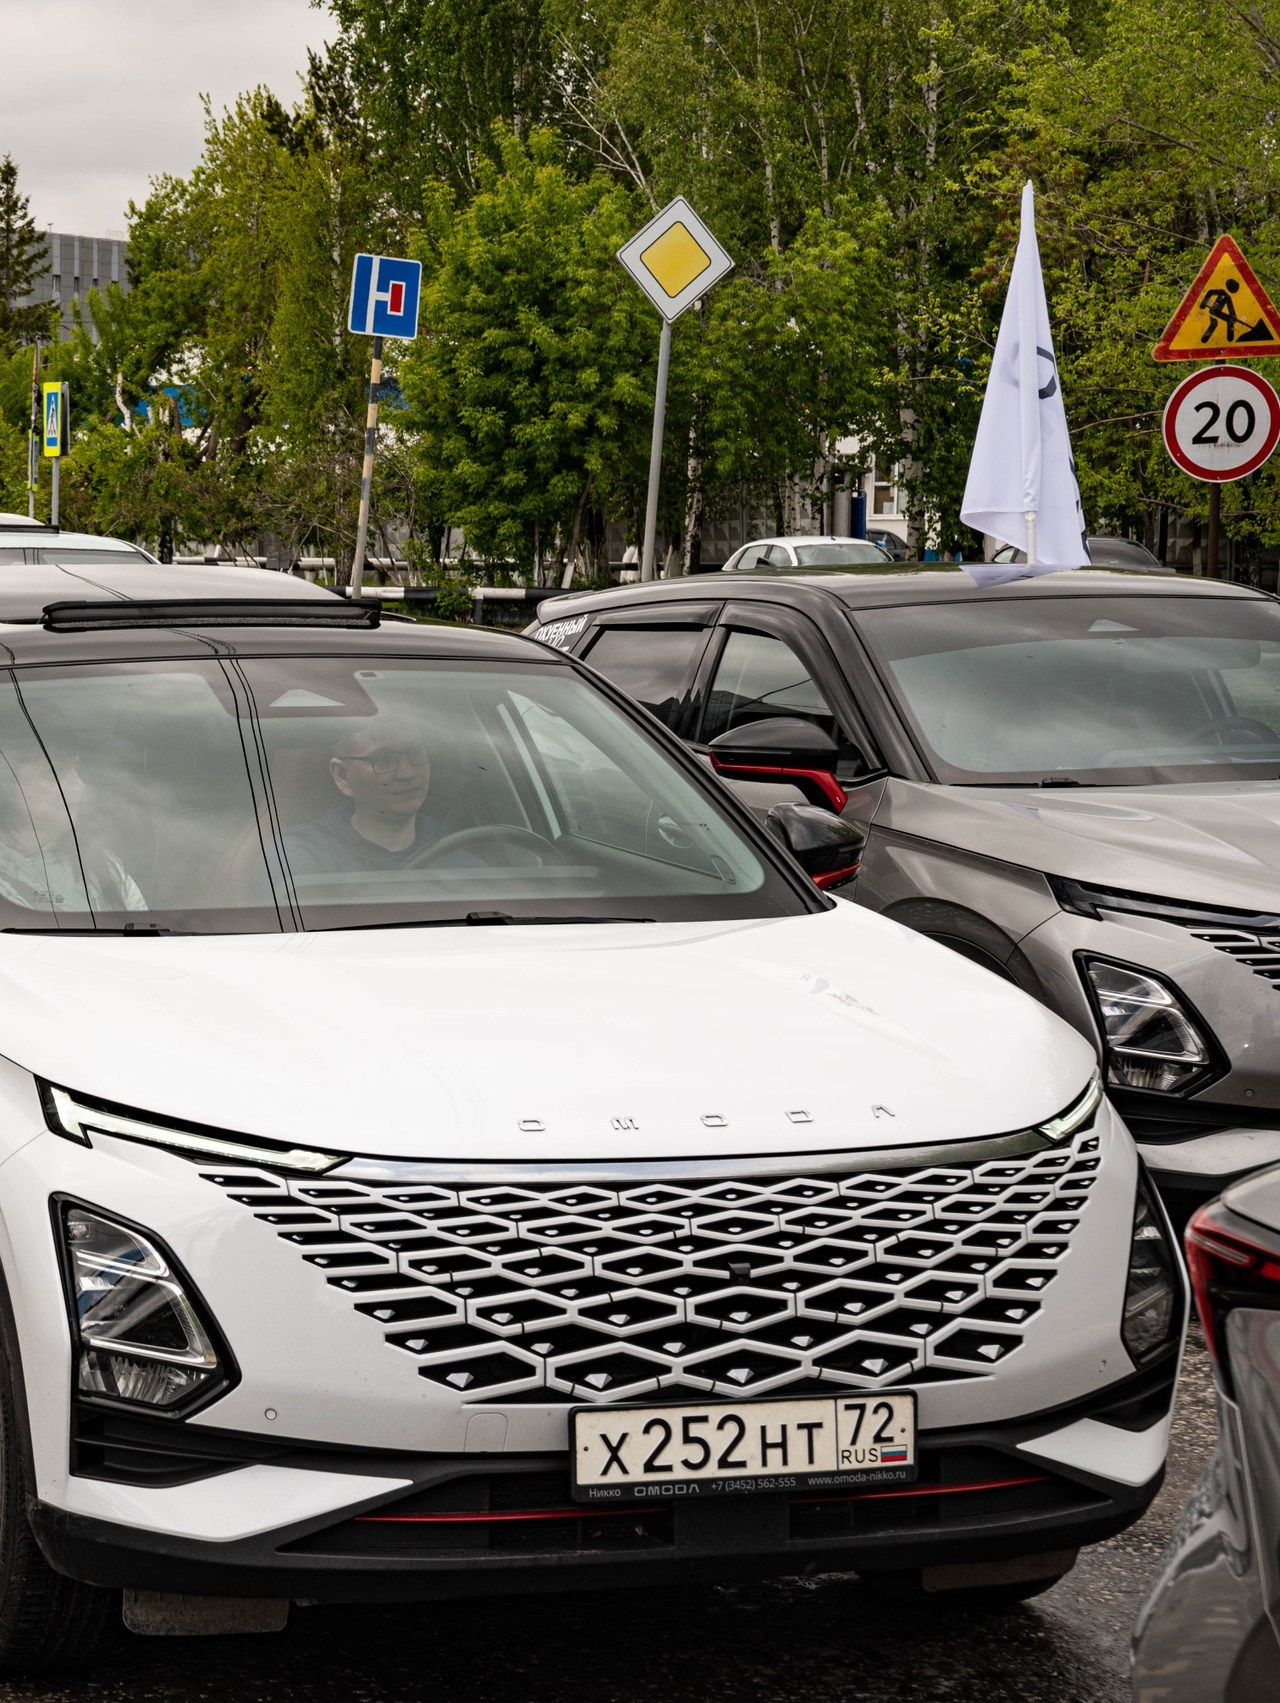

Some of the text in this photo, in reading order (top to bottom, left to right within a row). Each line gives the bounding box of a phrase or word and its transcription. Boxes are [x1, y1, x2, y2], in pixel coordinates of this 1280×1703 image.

[1192, 399, 1256, 445] 20
[844, 1401, 895, 1446] 72
[841, 1448, 879, 1464] RUS
[589, 1488, 621, 1498] Никко
[711, 1481, 723, 1491] +7
[725, 1479, 756, 1492] (3452)
[757, 1477, 796, 1489] 562-555
[808, 1470, 906, 1486] www.omoda-nikko.ru
